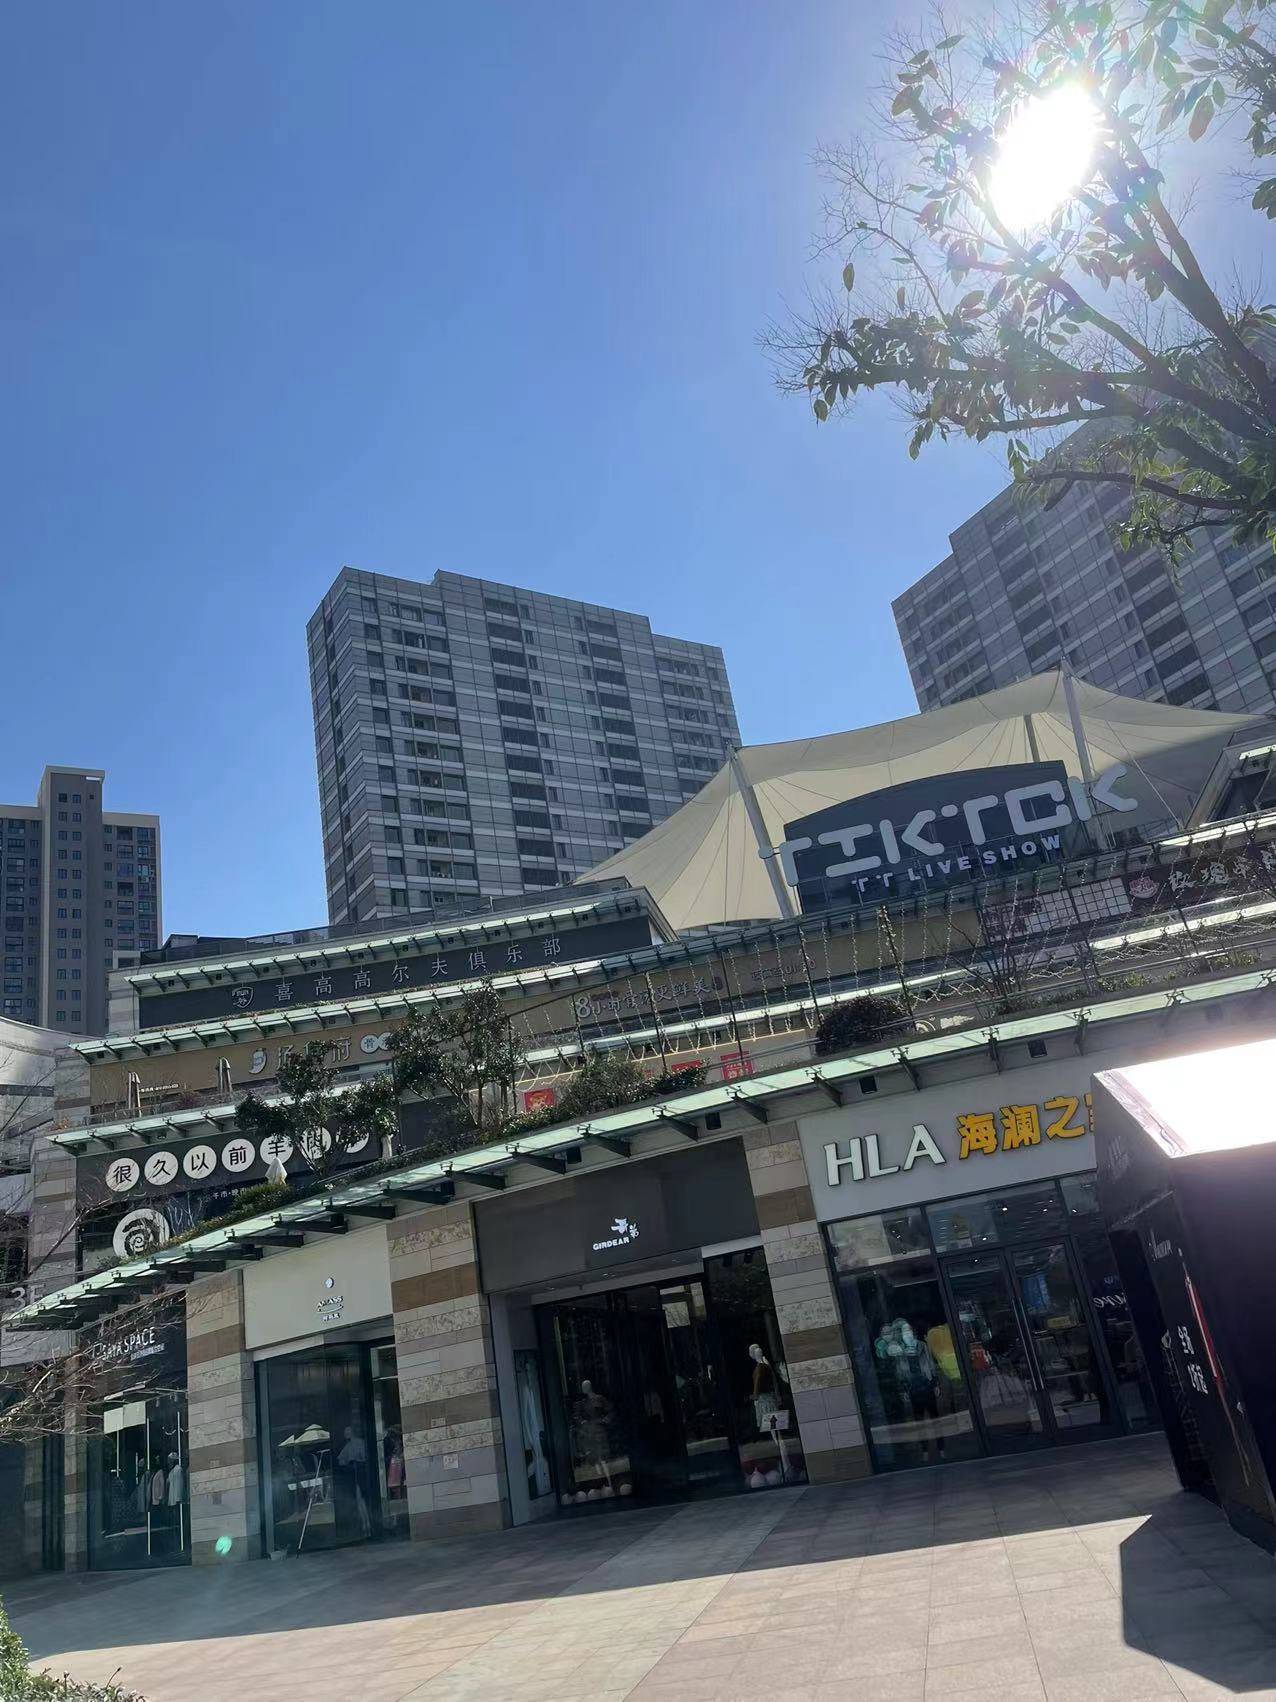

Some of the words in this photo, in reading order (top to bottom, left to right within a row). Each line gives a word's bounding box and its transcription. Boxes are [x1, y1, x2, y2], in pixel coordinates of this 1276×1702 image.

[907, 855, 972, 882] LIVE
[984, 833, 1062, 866] SHOW
[824, 1124, 946, 1186] HLA
[592, 1236, 629, 1251] GIRDEAR
